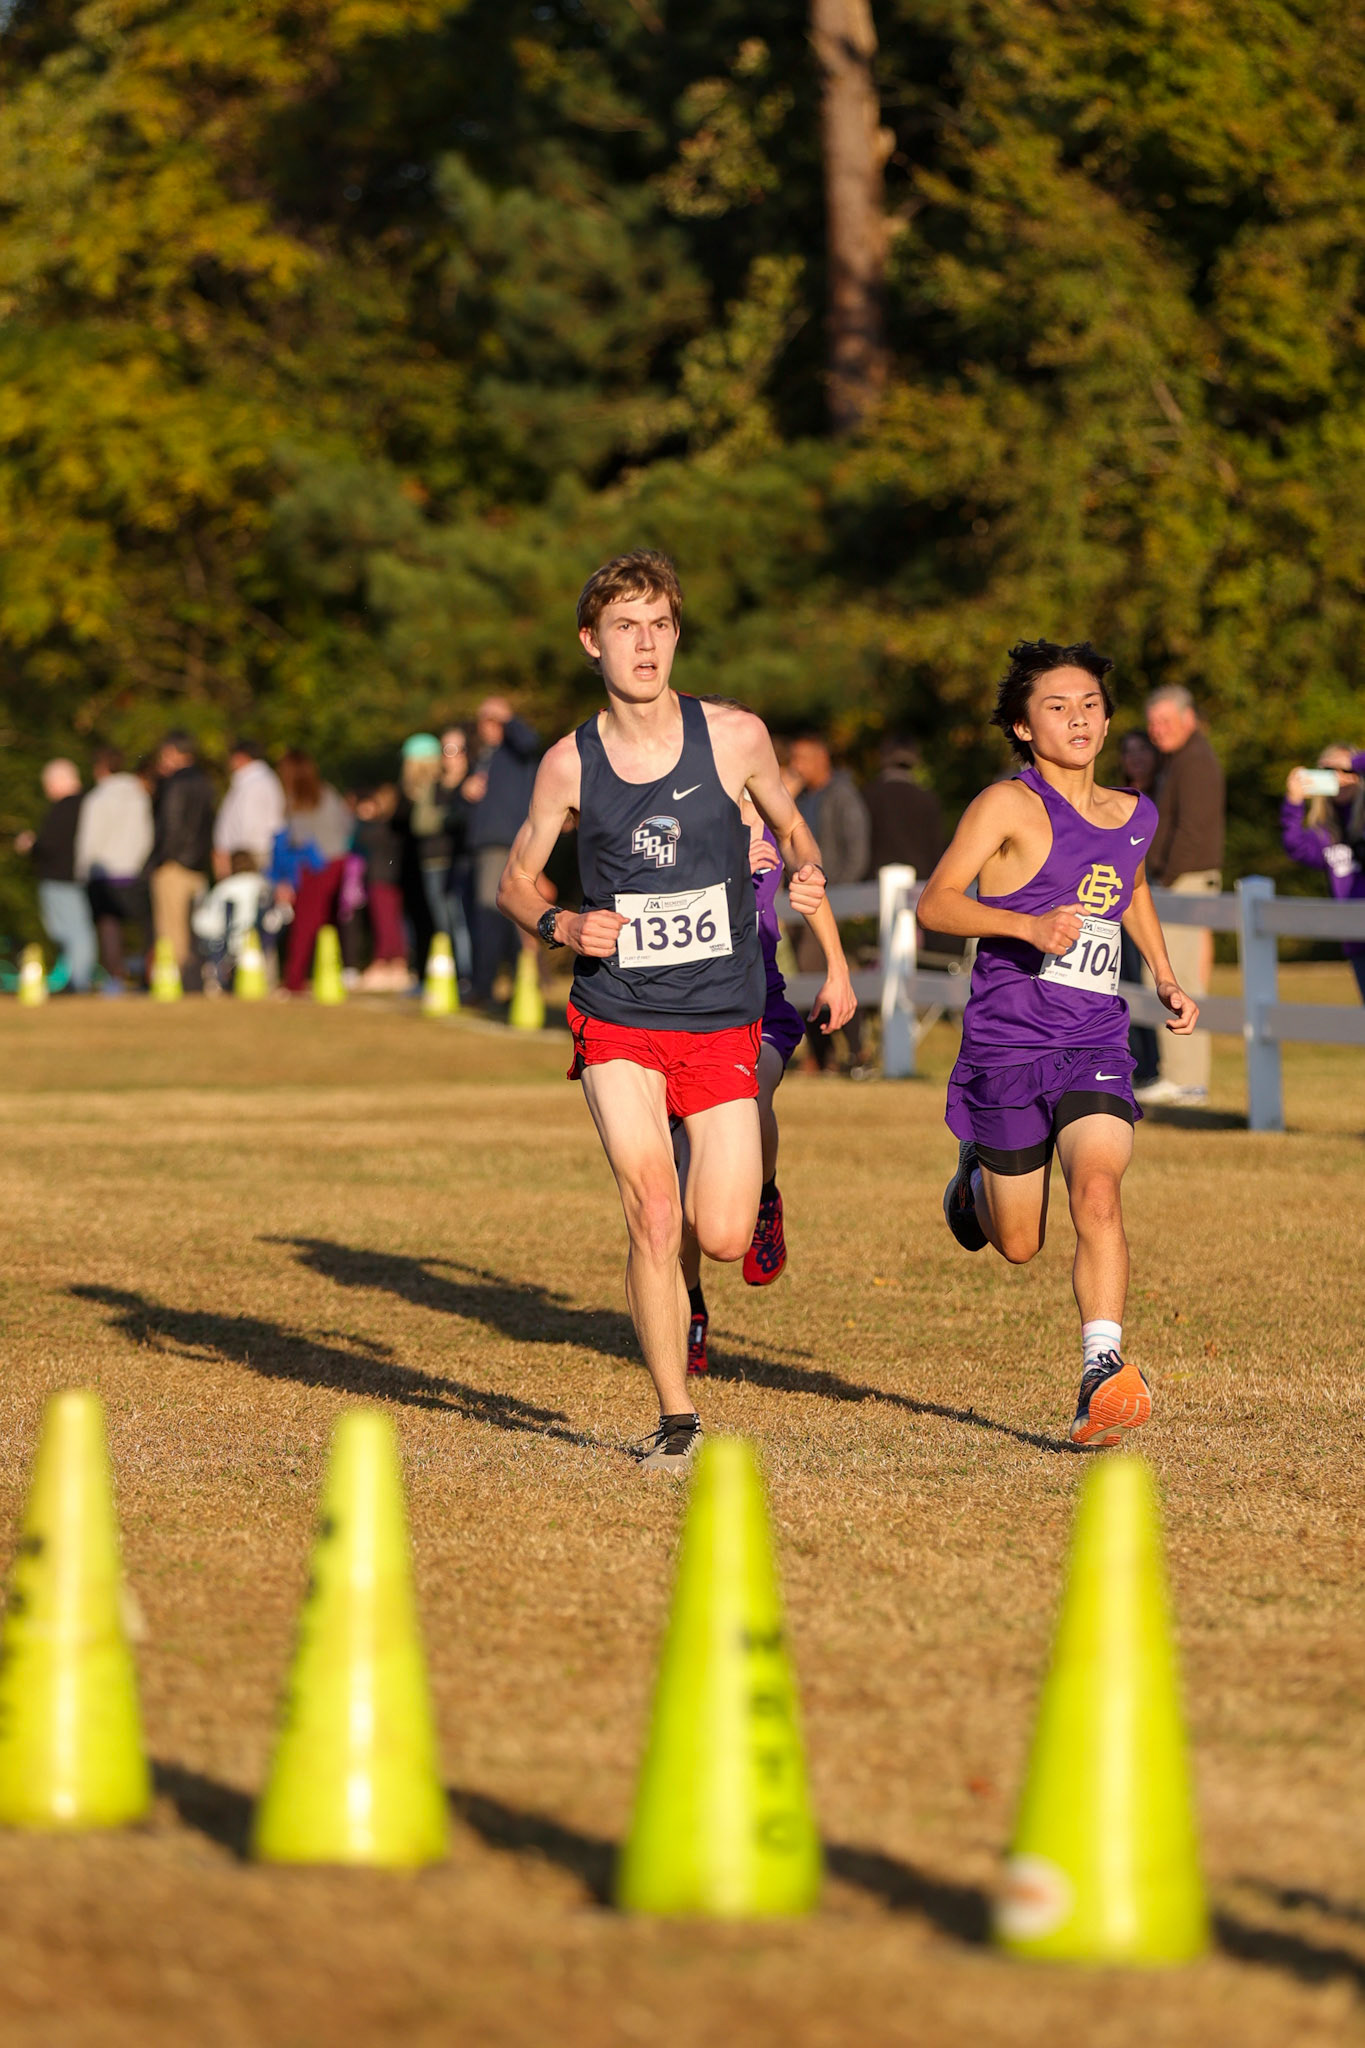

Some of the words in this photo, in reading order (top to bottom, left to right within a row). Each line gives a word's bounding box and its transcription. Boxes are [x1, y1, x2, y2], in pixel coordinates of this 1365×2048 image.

[634, 829, 673, 865] SBA
[650, 901, 661, 909] M
[631, 909, 716, 951] 1336
[1054, 940, 1120, 979] 2104
